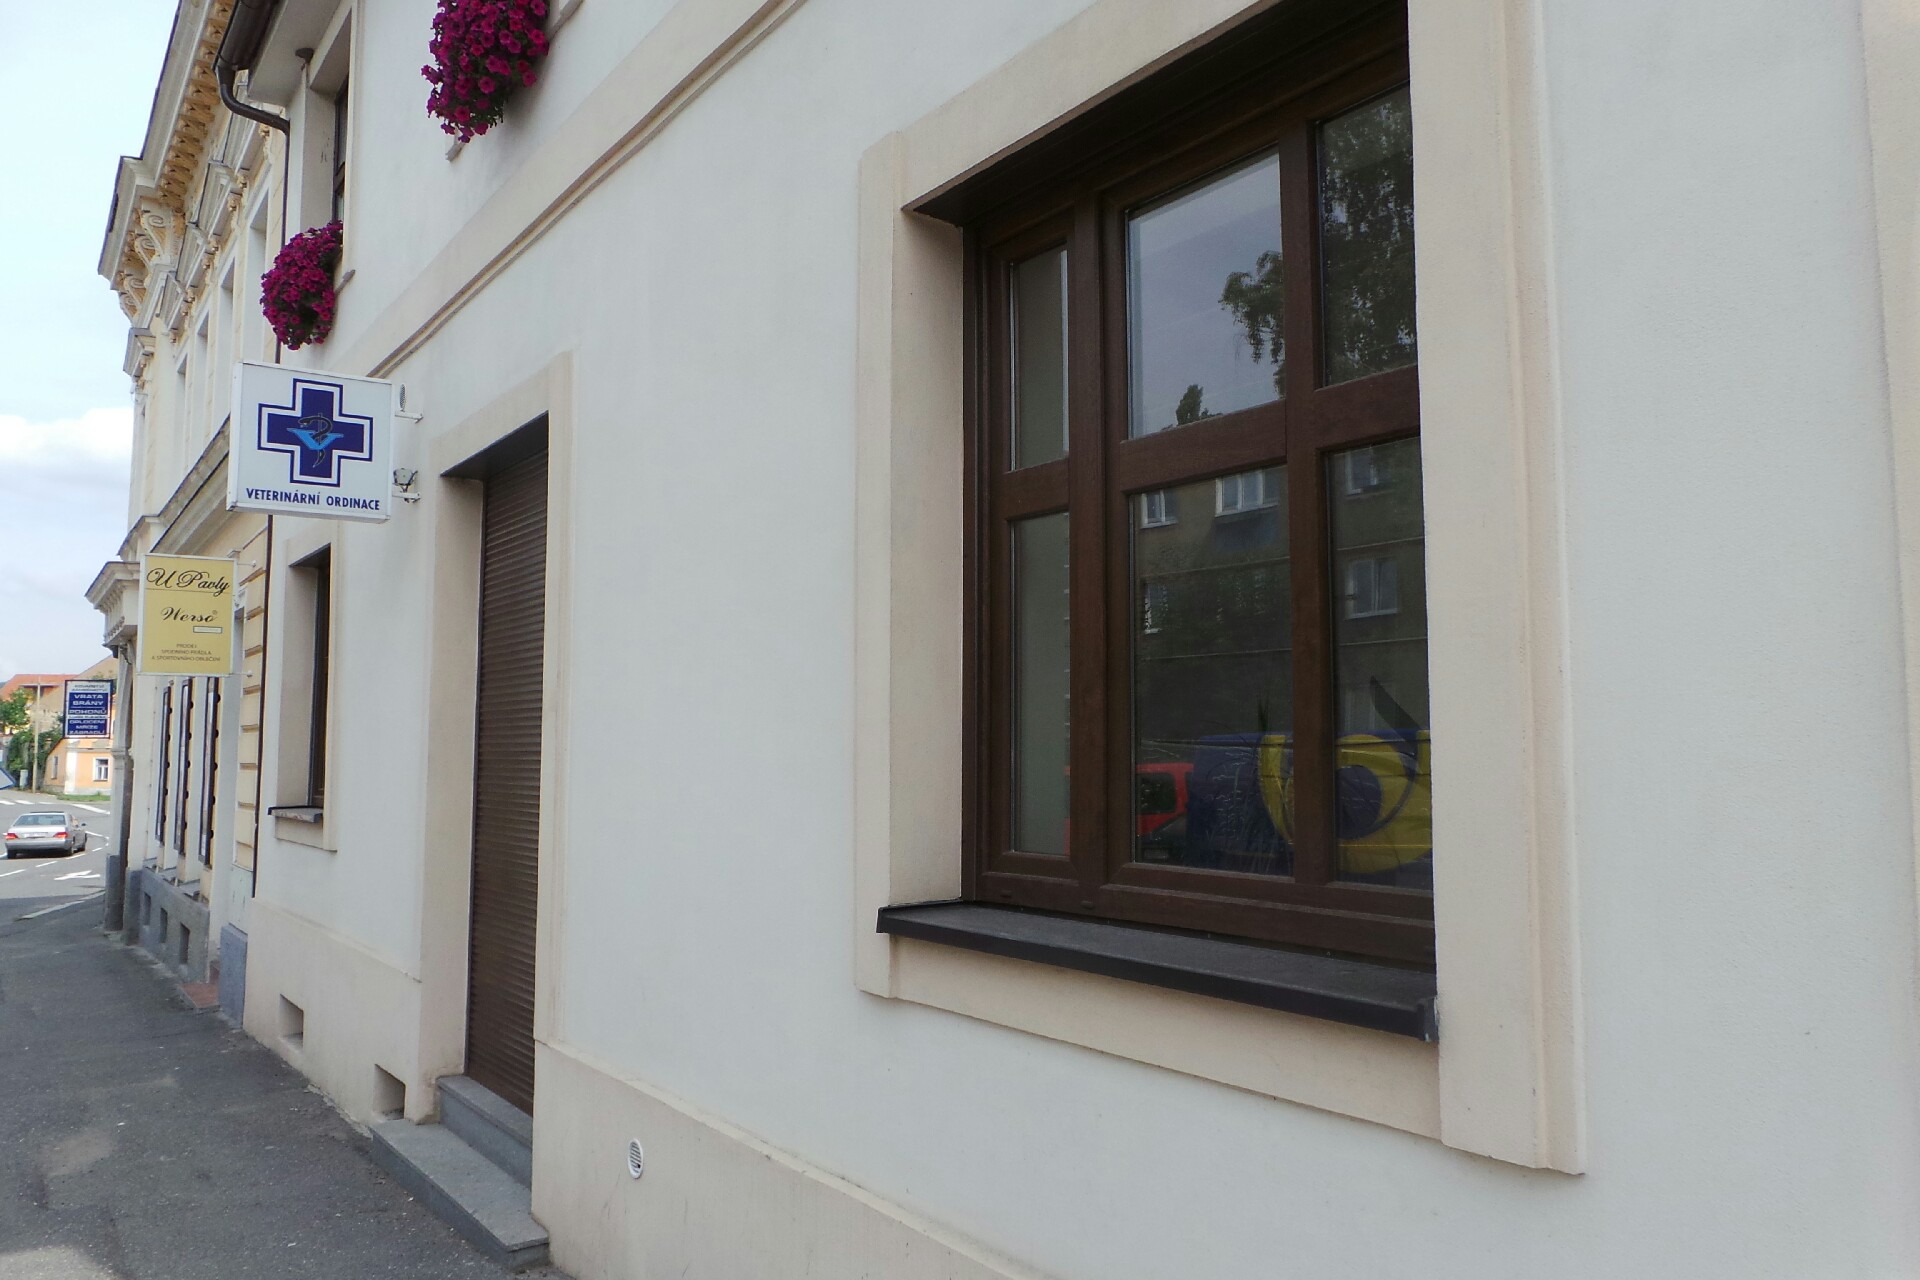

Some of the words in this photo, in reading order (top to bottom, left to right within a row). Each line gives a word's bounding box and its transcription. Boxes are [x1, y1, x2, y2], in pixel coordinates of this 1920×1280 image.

[246, 487, 320, 505] VETERINÁRNÍ
[326, 495, 380, 511] ORDINACE
[176, 569, 231, 598] Pavly
